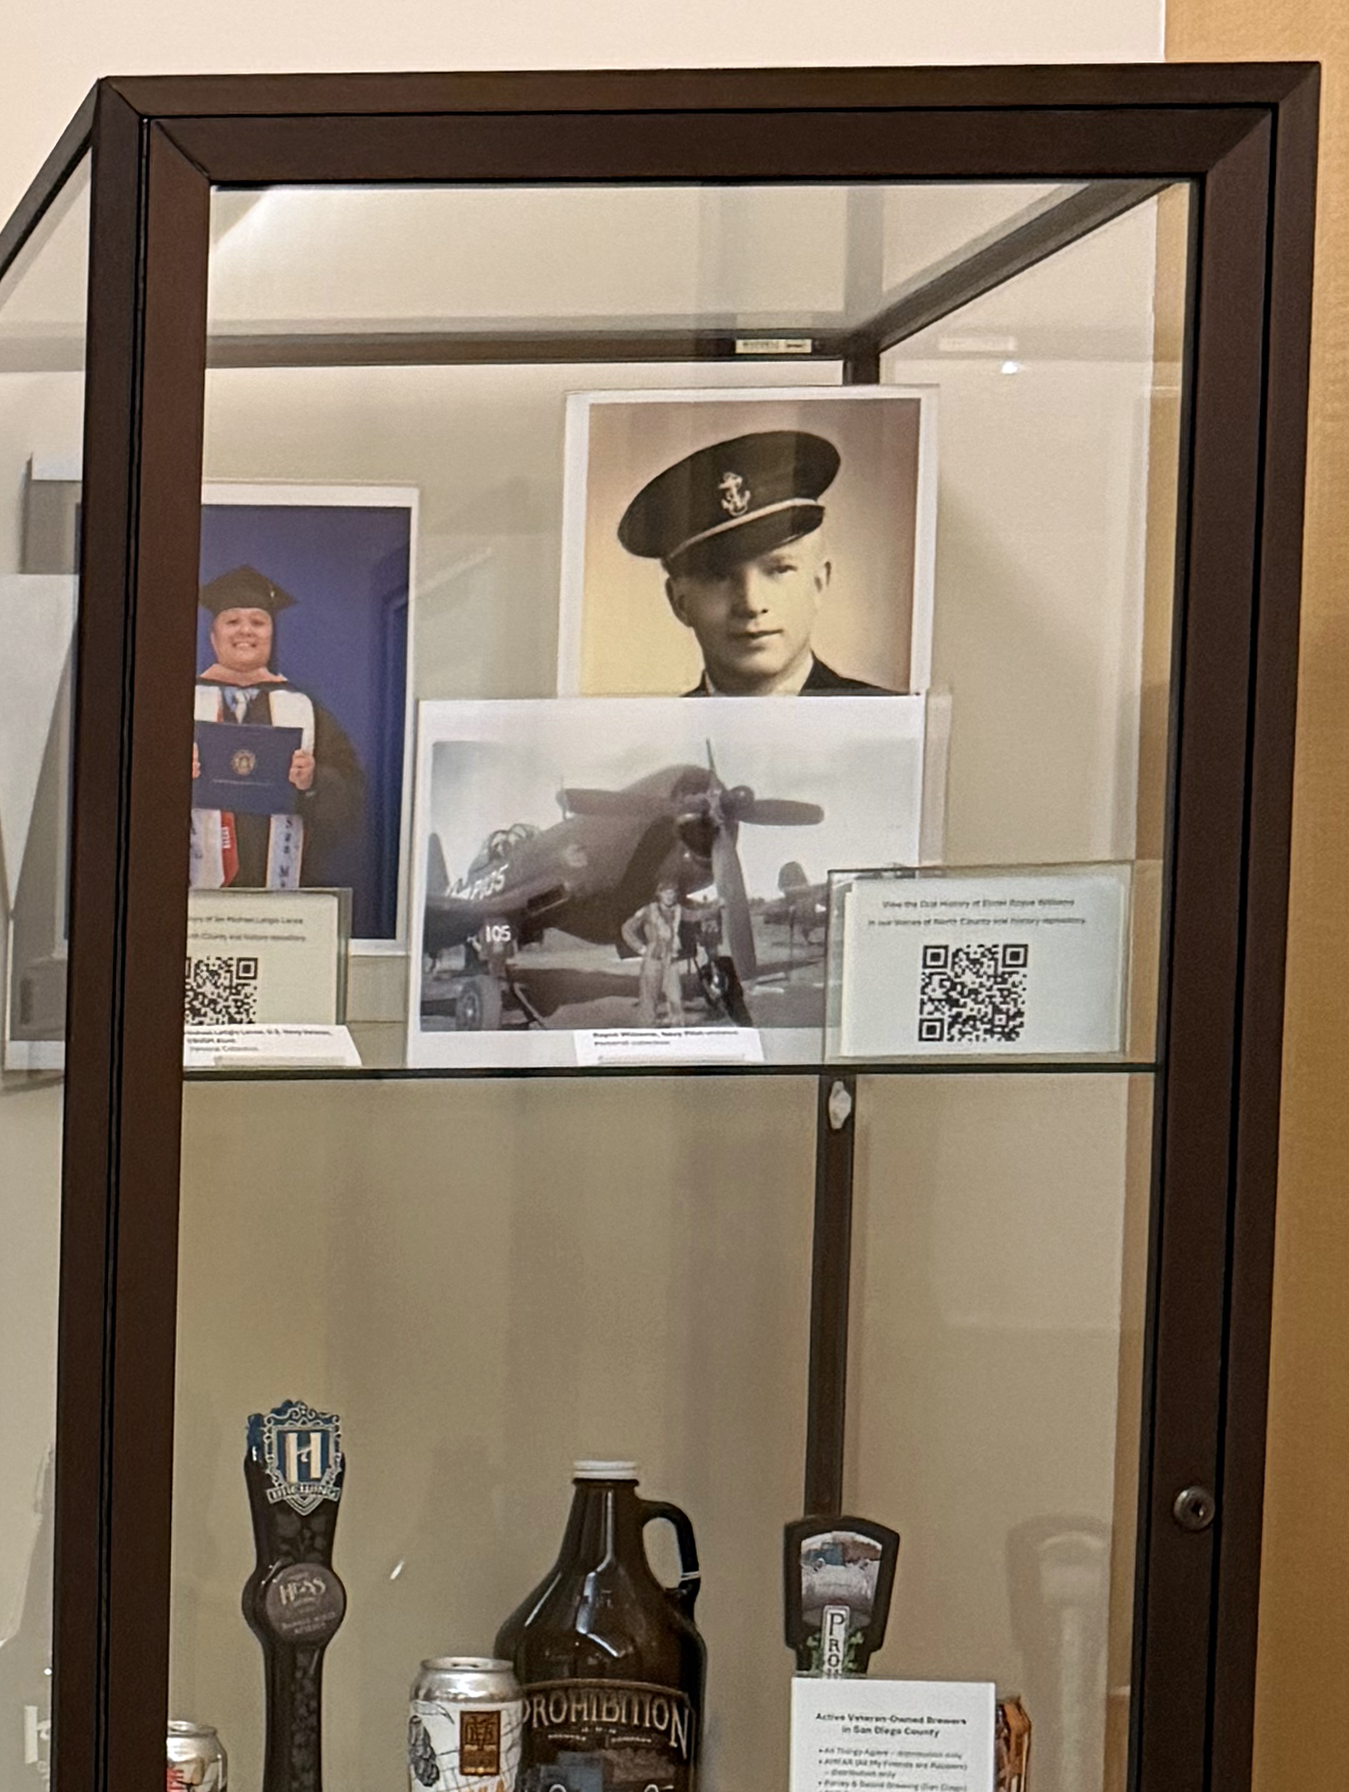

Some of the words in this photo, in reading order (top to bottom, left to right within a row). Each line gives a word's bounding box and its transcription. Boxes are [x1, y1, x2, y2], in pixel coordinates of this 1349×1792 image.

[485, 925, 511, 942] 105
[816, 1713, 845, 1721] Active
[853, 1726, 872, 1734] San
[874, 1727, 901, 1736] Diego
[904, 1728, 940, 1738] County
